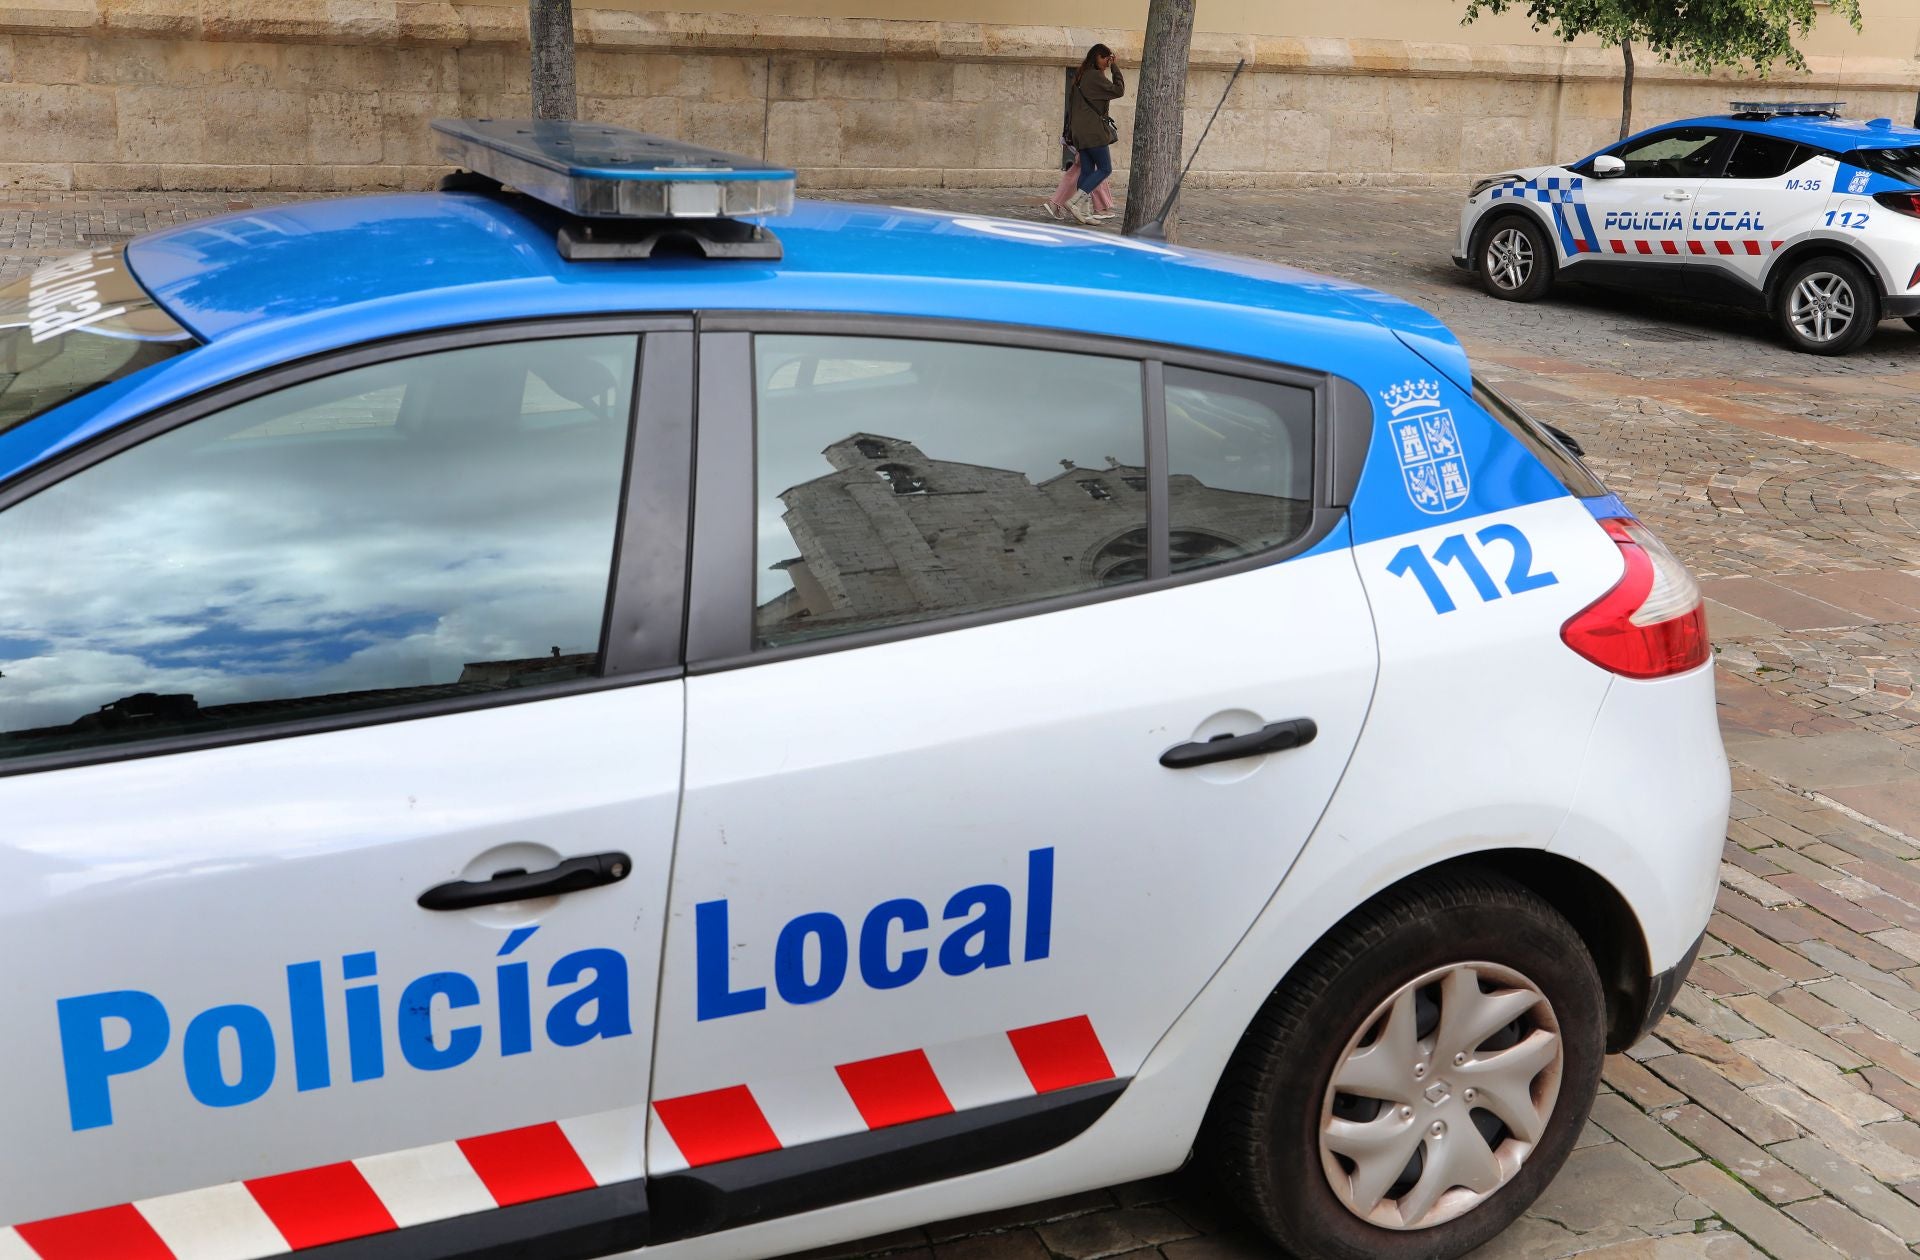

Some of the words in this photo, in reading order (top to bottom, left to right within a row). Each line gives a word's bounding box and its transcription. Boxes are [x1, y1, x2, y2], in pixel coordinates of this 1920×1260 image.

[1785, 179, 1821, 191] M-35
[1692, 211, 1764, 231] LOCAL
[1825, 210, 1869, 229] 112
[1386, 524, 1558, 614] 112
[57, 926, 632, 1132] Policía
[695, 846, 1054, 1021] Local
